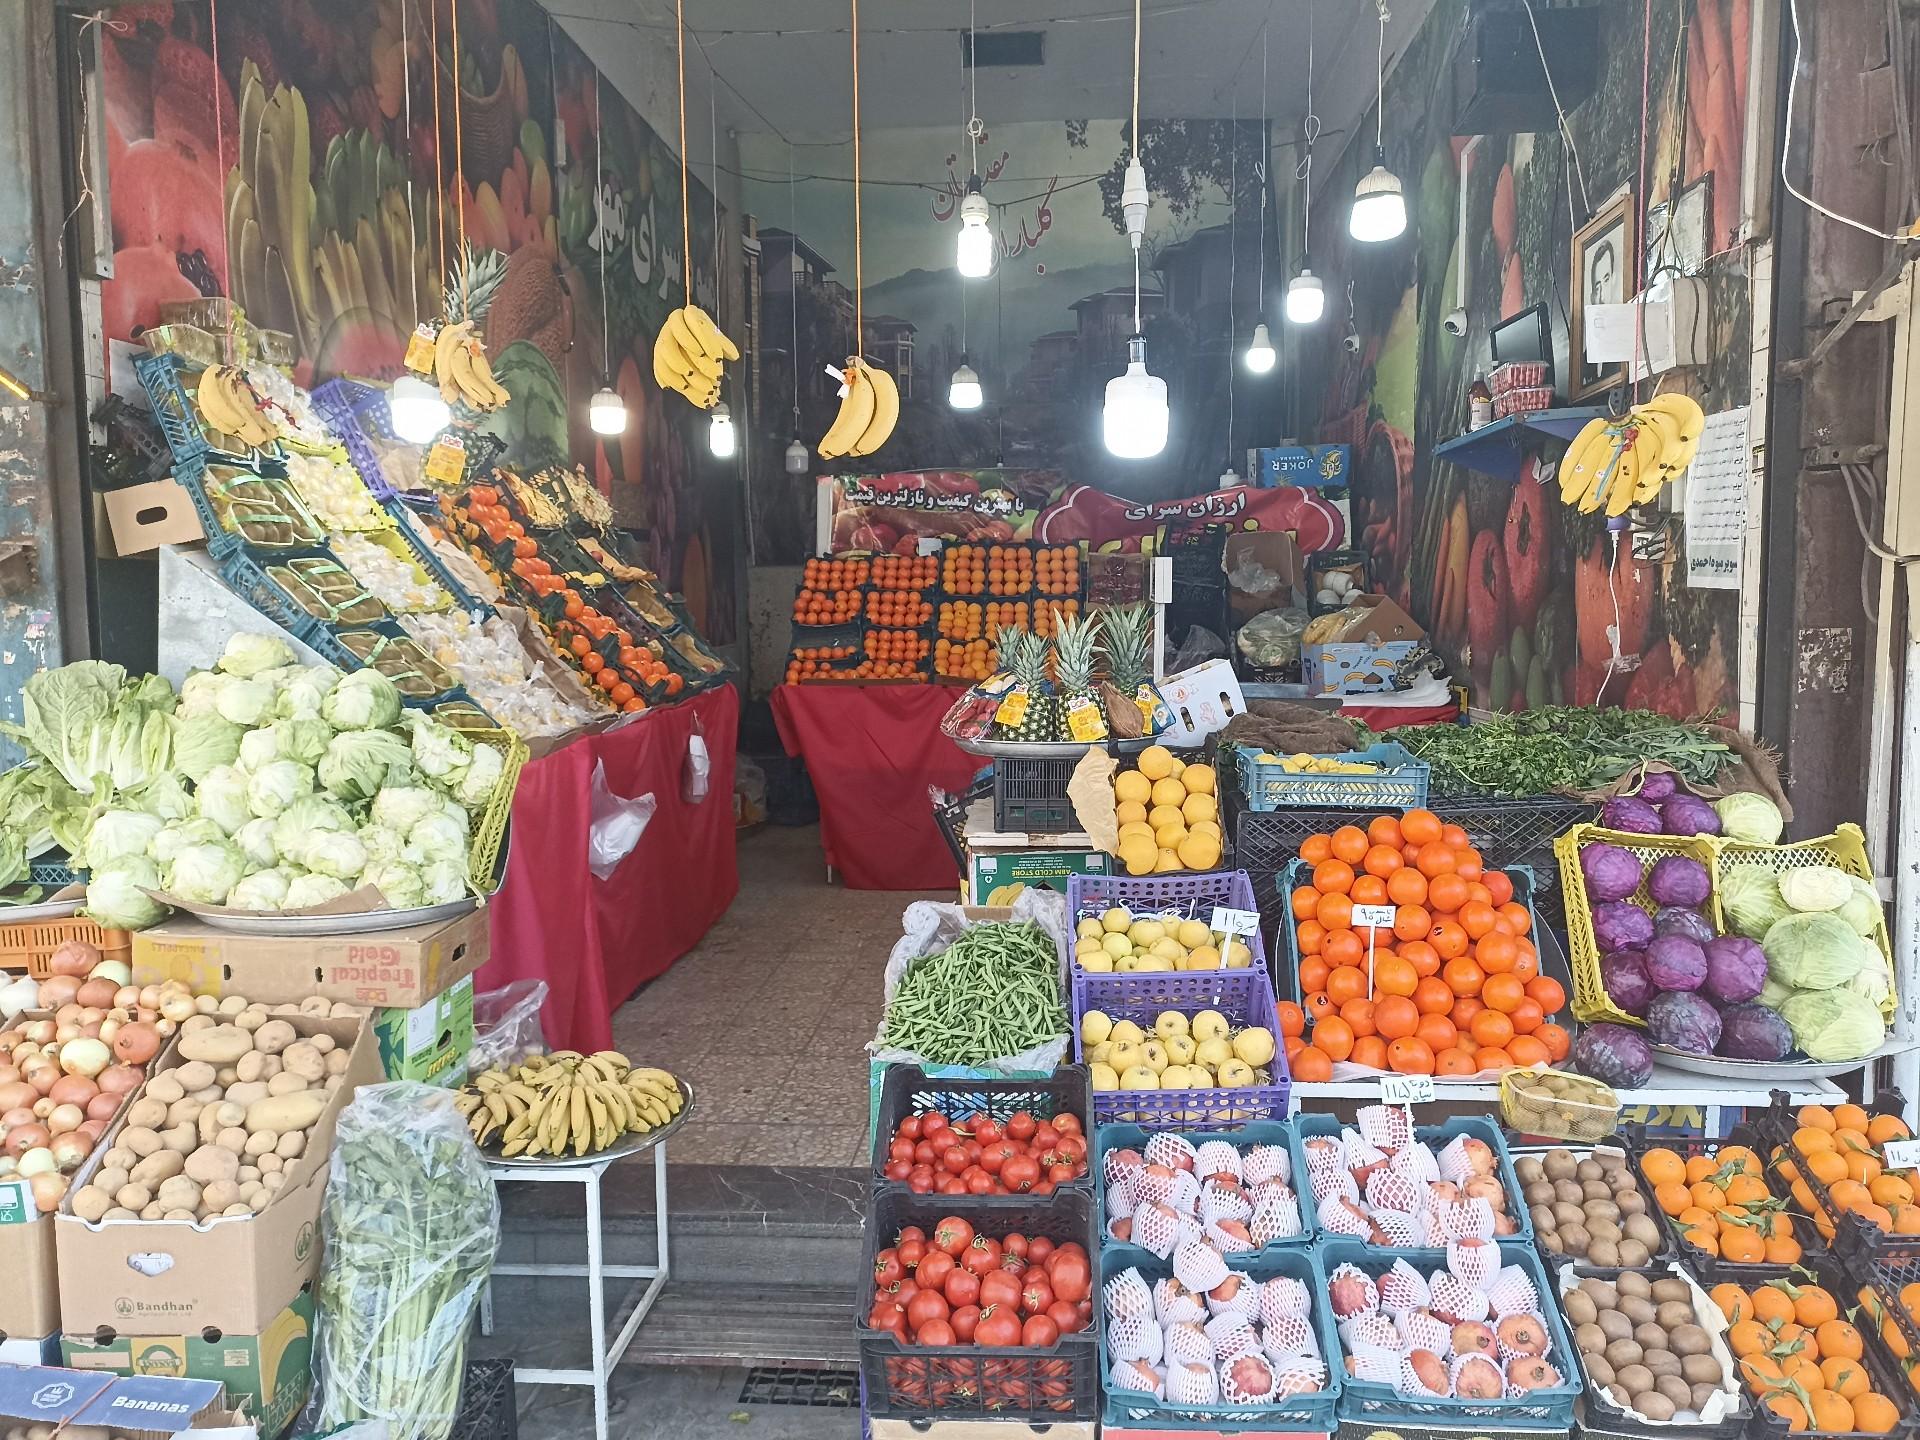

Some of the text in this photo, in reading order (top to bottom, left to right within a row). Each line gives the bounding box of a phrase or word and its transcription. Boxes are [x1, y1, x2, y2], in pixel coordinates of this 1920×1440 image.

[1271, 457, 1314, 472] JOKER
[845, 485, 874, 504] قیمت
[925, 496, 934, 509] و
[936, 493, 972, 510] کیفیت
[973, 496, 1012, 518] بهترین
[1015, 497, 1024, 516] با
[1125, 491, 1246, 520] ارزان سرای
[349, 945, 400, 966] Gold
[331, 966, 415, 990] Tropical
[136, 1300, 194, 1312] Bandhan
[111, 1396, 190, 1415] Bananas
